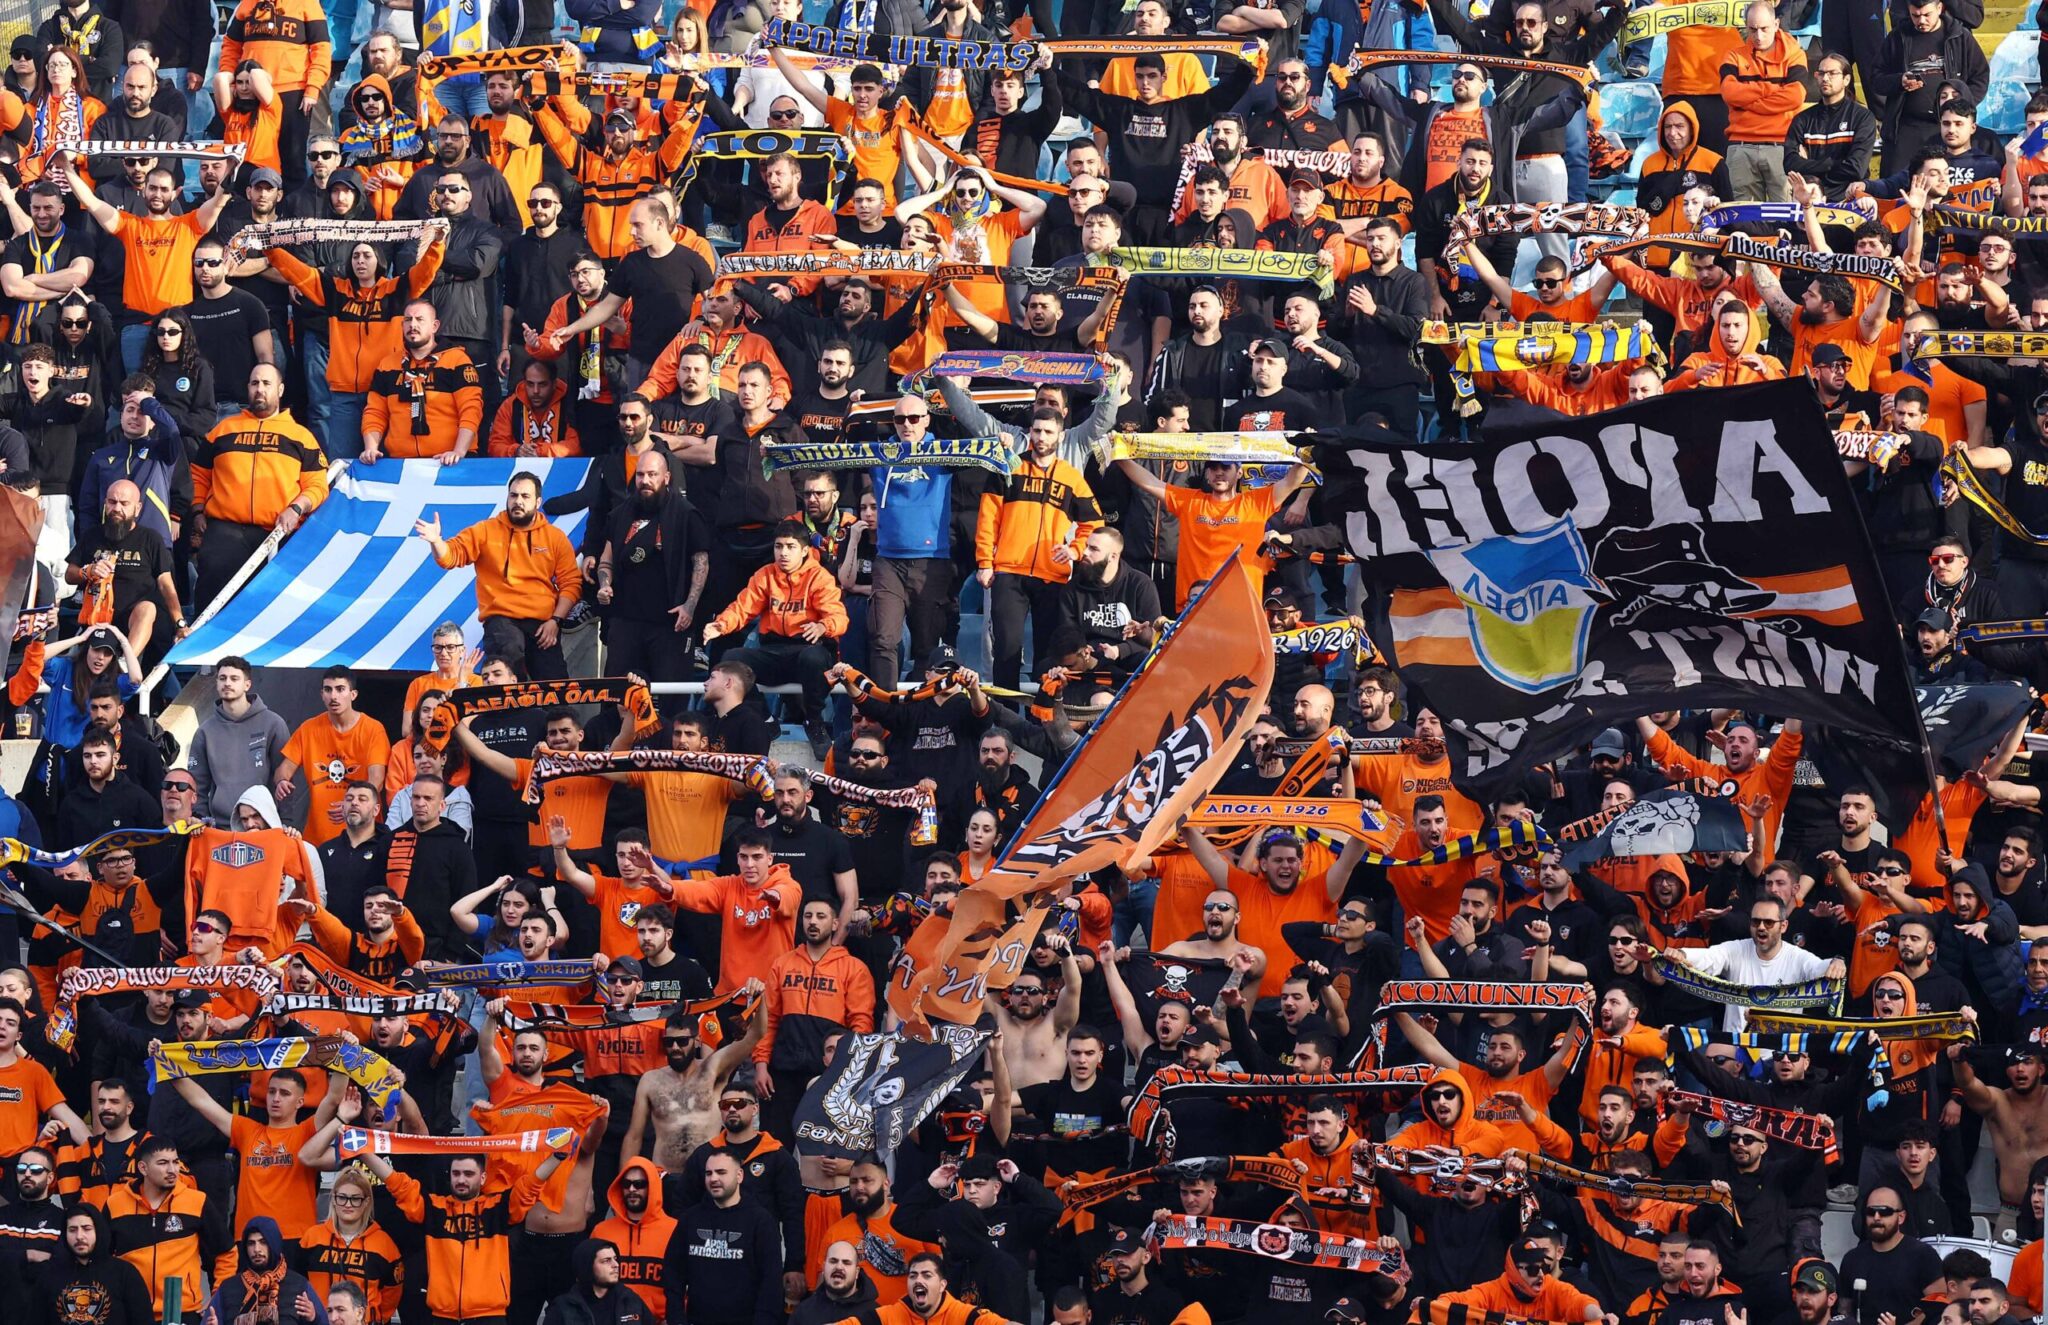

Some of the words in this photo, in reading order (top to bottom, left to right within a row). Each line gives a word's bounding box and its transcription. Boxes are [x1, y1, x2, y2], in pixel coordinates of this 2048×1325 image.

[281, 21, 297, 38] FC
[764, 17, 878, 61] APOEL
[889, 35, 1035, 72] ULTRAS
[1342, 201, 1380, 217] ΑΠΕΛ
[1023, 360, 1086, 376] ORIGINAL
[1022, 477, 1065, 499] ΑΠΕΛ
[1084, 611, 1117, 620] NORTH
[1097, 603, 1117, 612] THE
[1091, 619, 1117, 628] FACE
[1298, 626, 1355, 655] 1926
[502, 682, 543, 696] ΓΙΑ
[463, 692, 560, 716] ΑΔΕΛΦΙΑ
[1206, 804, 1272, 815] ΑΠΟΕΛ
[1285, 803, 1330, 816] 1926
[782, 974, 837, 993] APOEL
[345, 996, 385, 1014] WE
[597, 1040, 645, 1055] APOEL
[481, 1138, 518, 1147] ΙΣΤΟΡΙΑ
[1244, 1160, 1261, 1171] ON
[1264, 1163, 1297, 1183] TOUR
[1184, 1221, 1208, 1248] just
[1209, 1229, 1219, 1242] a
[1220, 1223, 1253, 1250] badge
[1311, 1241, 1322, 1256] a
[1321, 1234, 1362, 1263] family
[689, 1245, 744, 1260] NATIONALISTS
[646, 1262, 663, 1282] FC
